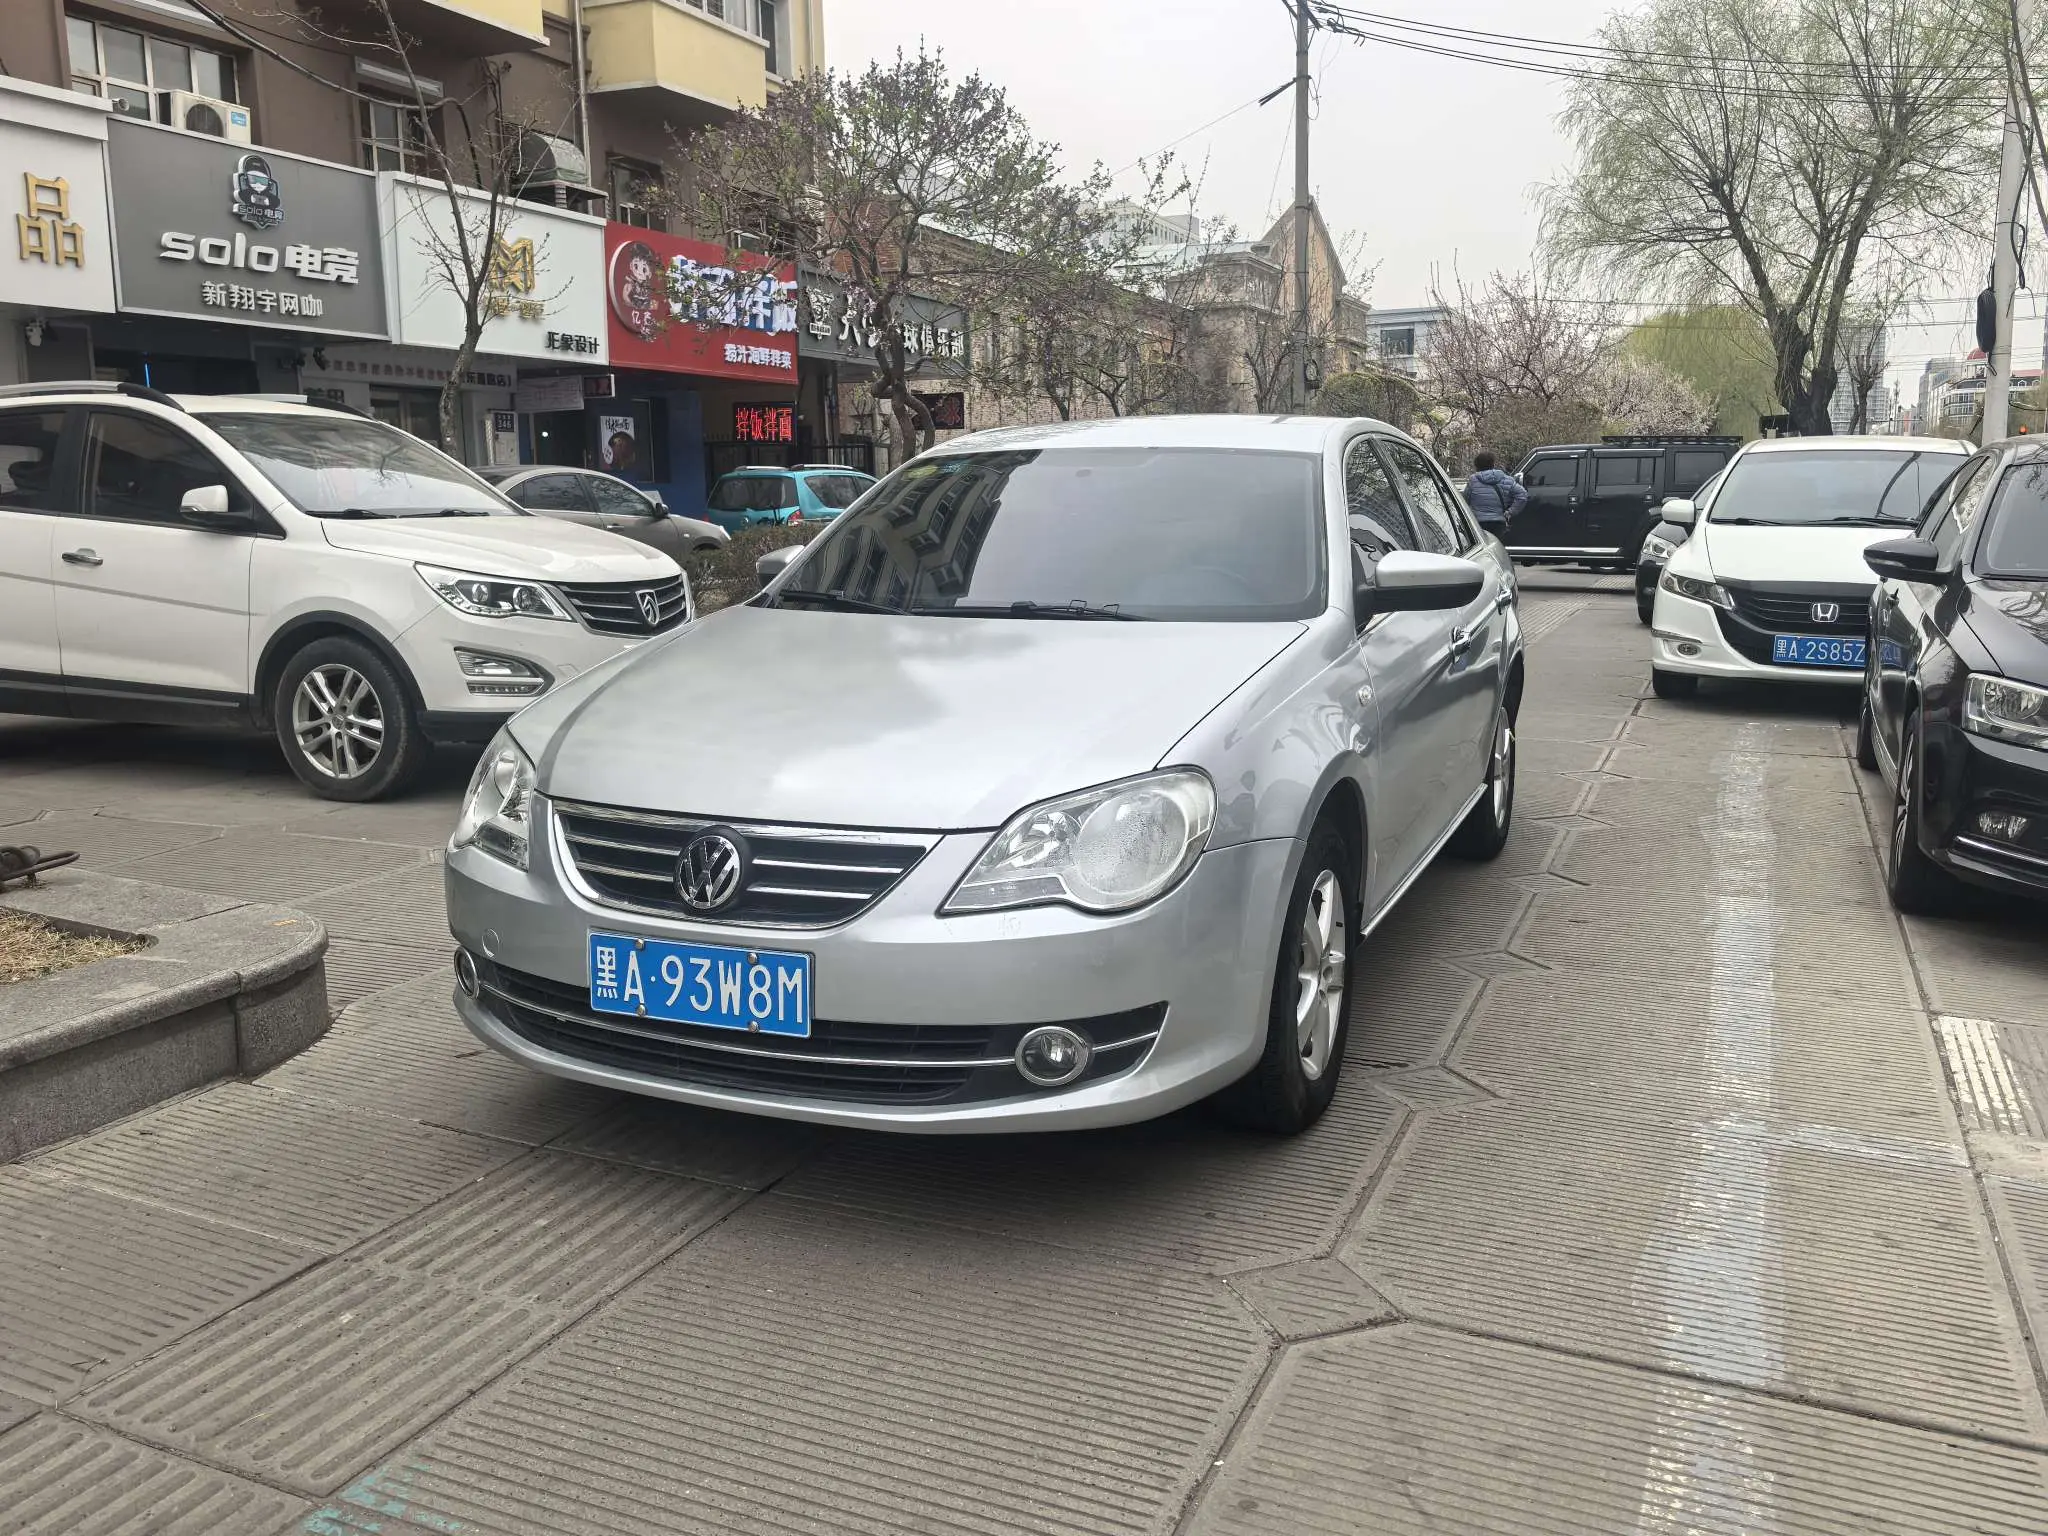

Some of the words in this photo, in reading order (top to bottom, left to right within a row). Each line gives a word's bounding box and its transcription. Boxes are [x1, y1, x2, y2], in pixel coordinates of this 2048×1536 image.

[16, 172, 85, 267] 品
[160, 231, 279, 273] solo
[285, 244, 359, 284] 电竞
[201, 280, 323, 317] 新翔宇网咖
[736, 407, 793, 441] 拌饭拌面
[1776, 639, 1866, 664] 黑A·2S85Z
[596, 946, 804, 1024] 黑A·93W8M
